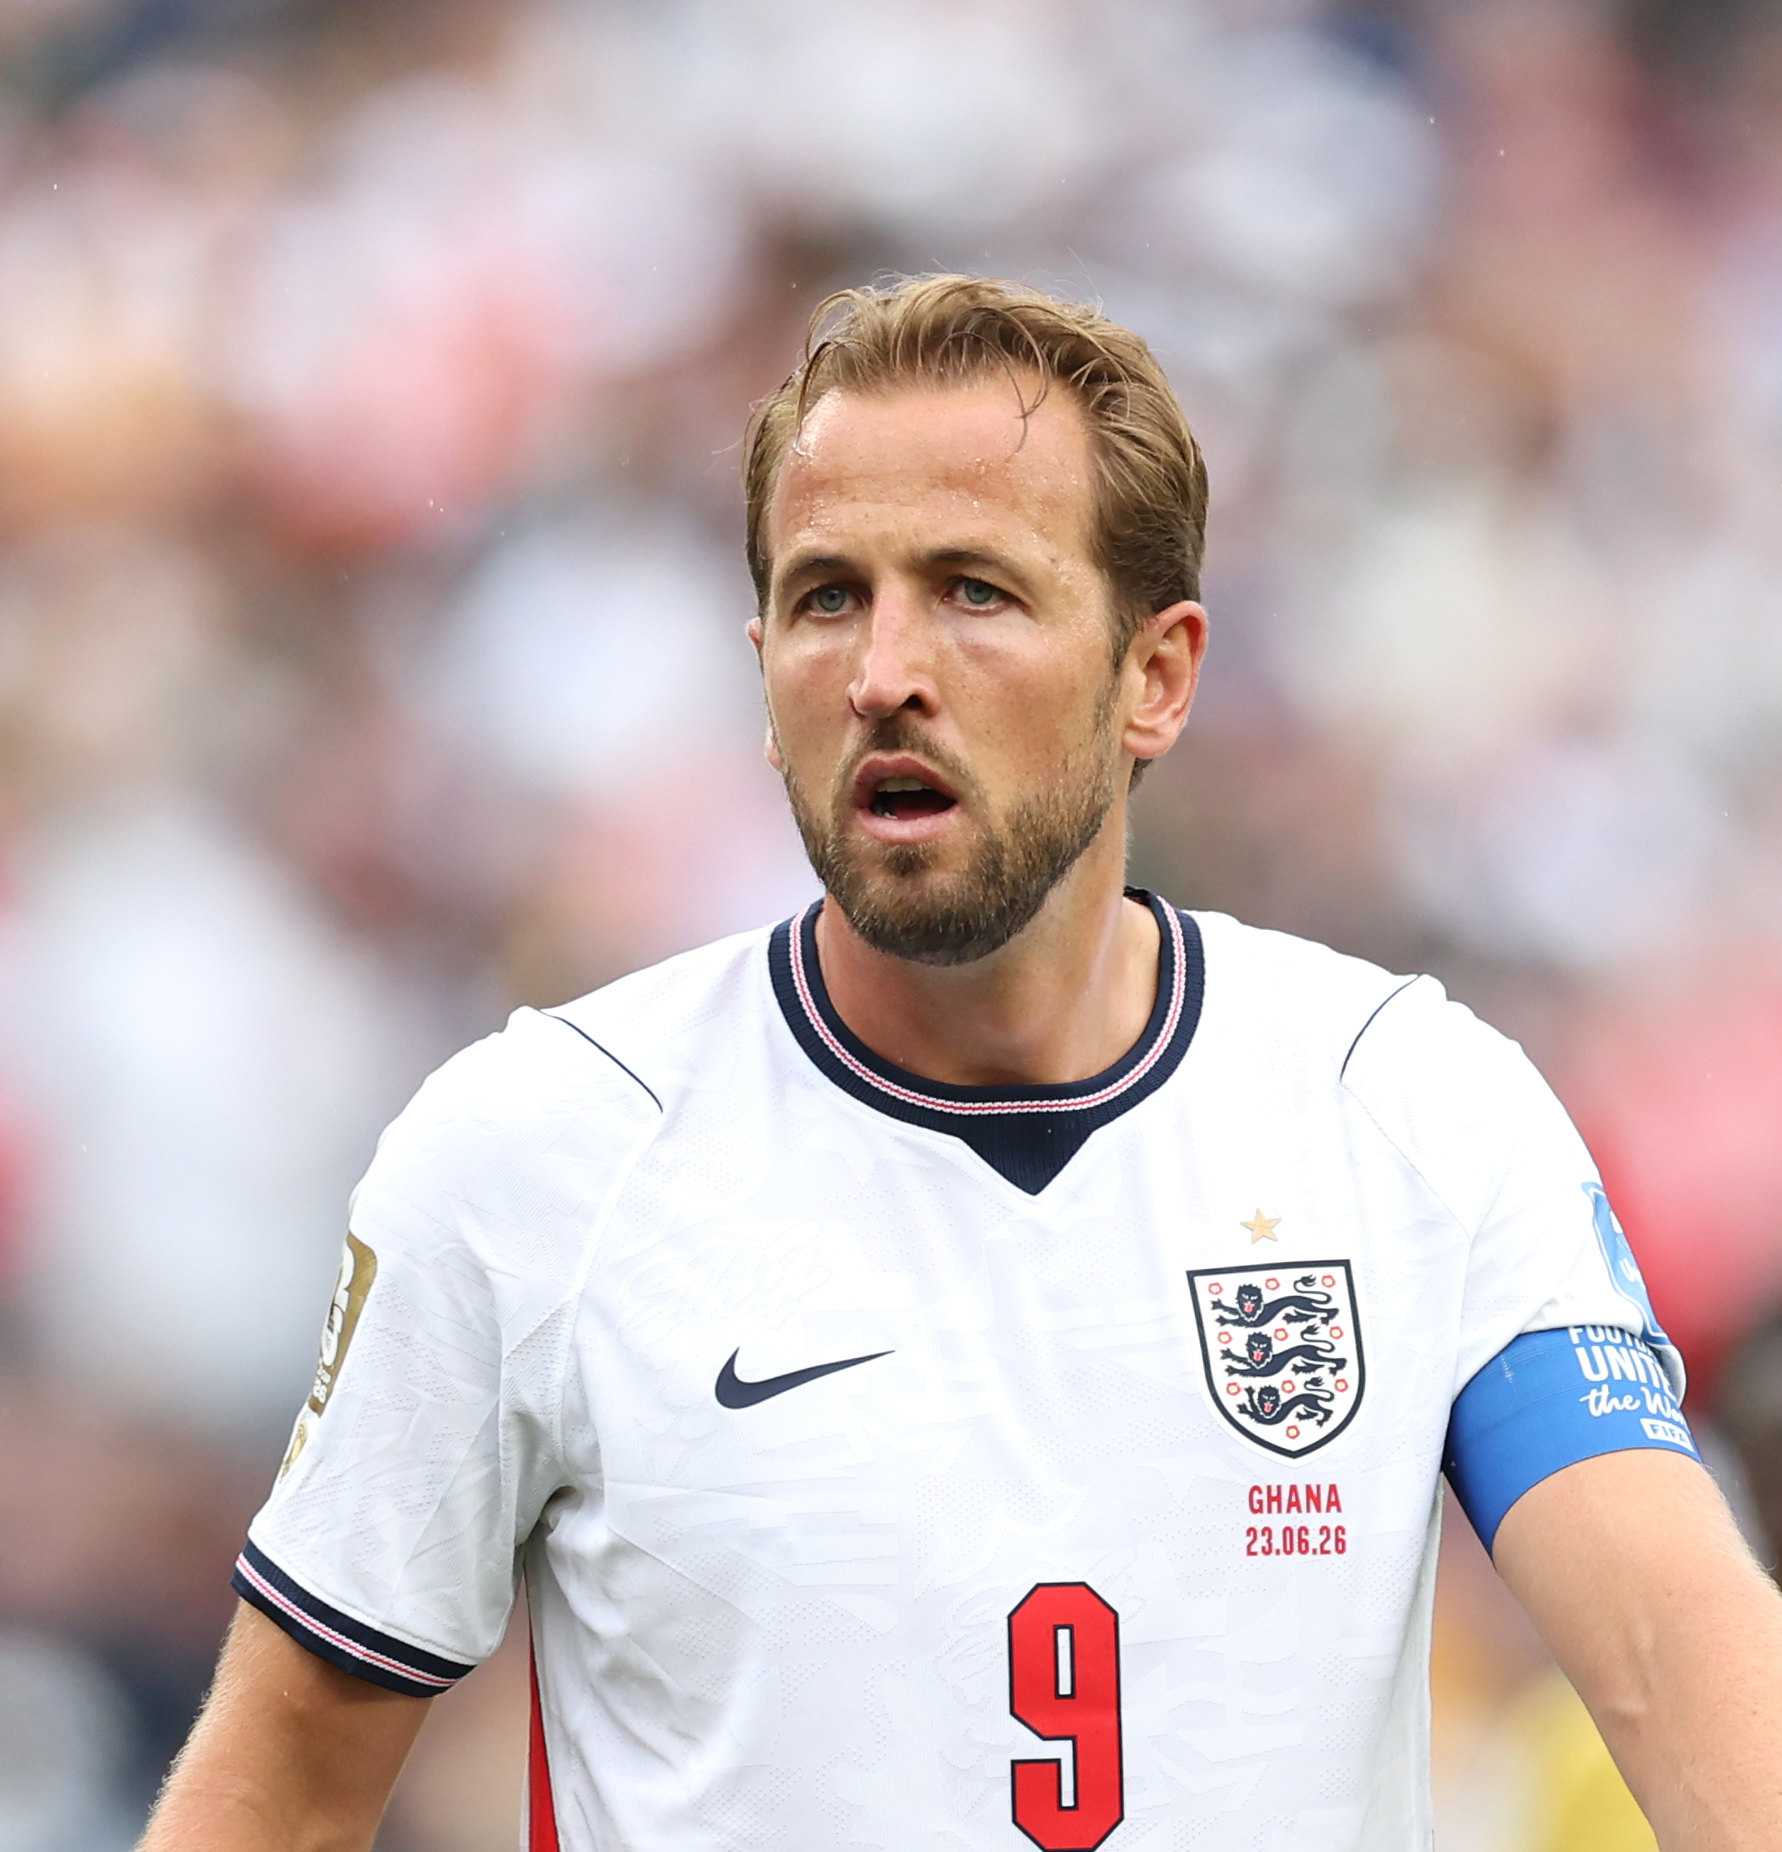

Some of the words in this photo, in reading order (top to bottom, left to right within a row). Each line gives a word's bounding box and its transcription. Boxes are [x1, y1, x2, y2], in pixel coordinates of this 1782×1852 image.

[1575, 1345, 1677, 1401] UNITE
[1579, 1383, 1641, 1417] the
[1248, 1484, 1343, 1515] GHANA
[1246, 1525, 1347, 1557] 23.06.26
